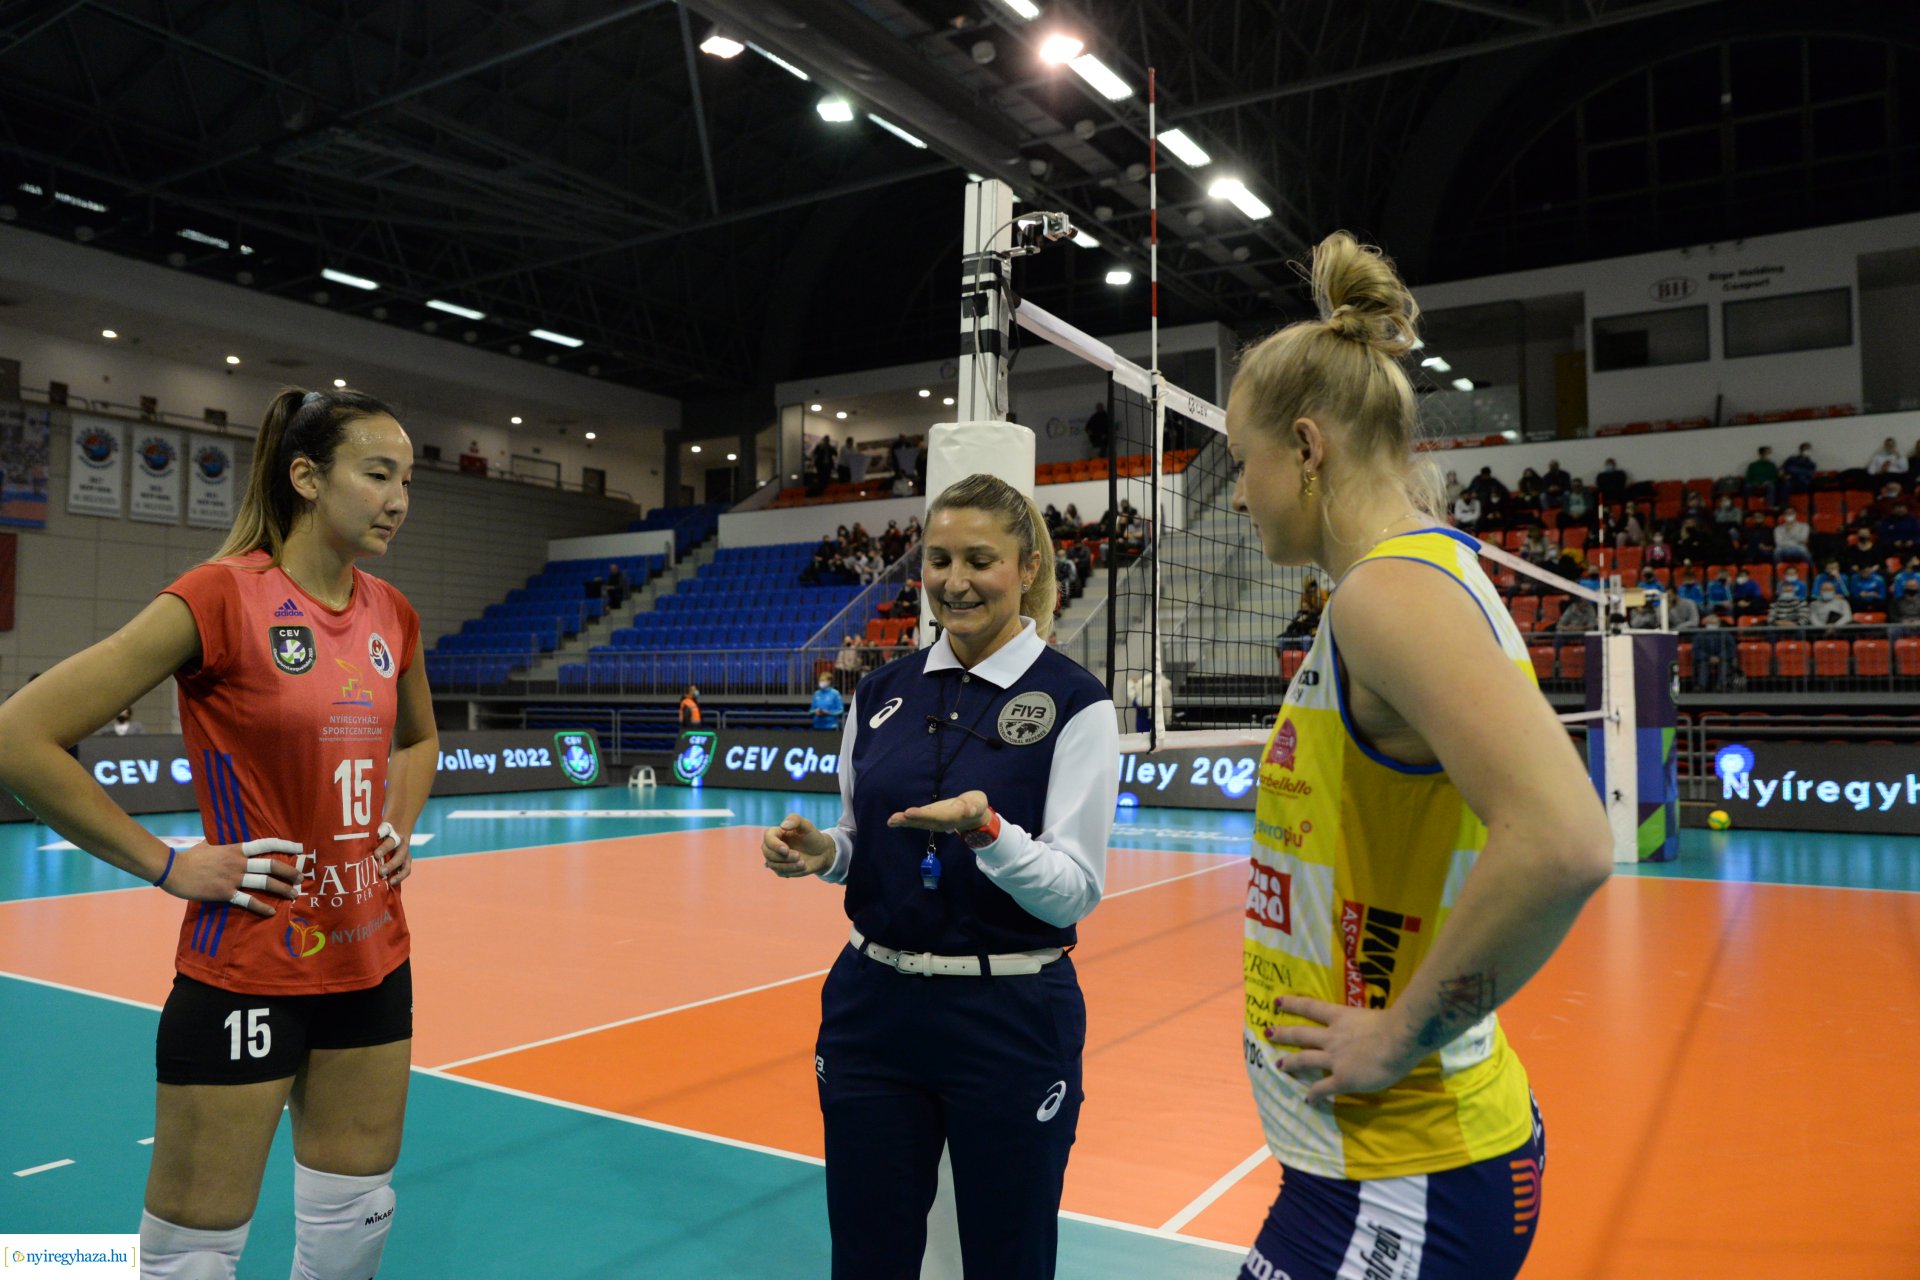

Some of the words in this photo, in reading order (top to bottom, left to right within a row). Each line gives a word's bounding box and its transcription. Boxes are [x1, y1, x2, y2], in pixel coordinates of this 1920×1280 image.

[274, 609, 304, 617] adidas
[279, 629, 300, 637] CEV
[330, 714, 379, 724] NYÍREGYHÁZI
[1011, 704, 1046, 719] FIVB
[323, 727, 382, 735] SPORTCENTRUM
[503, 748, 551, 768] 2022
[725, 746, 779, 771] CEV
[784, 747, 841, 775] Cha
[94, 760, 159, 786] CEV
[1190, 757, 1261, 786] 202
[334, 759, 373, 827] 15
[224, 1008, 272, 1061] 15
